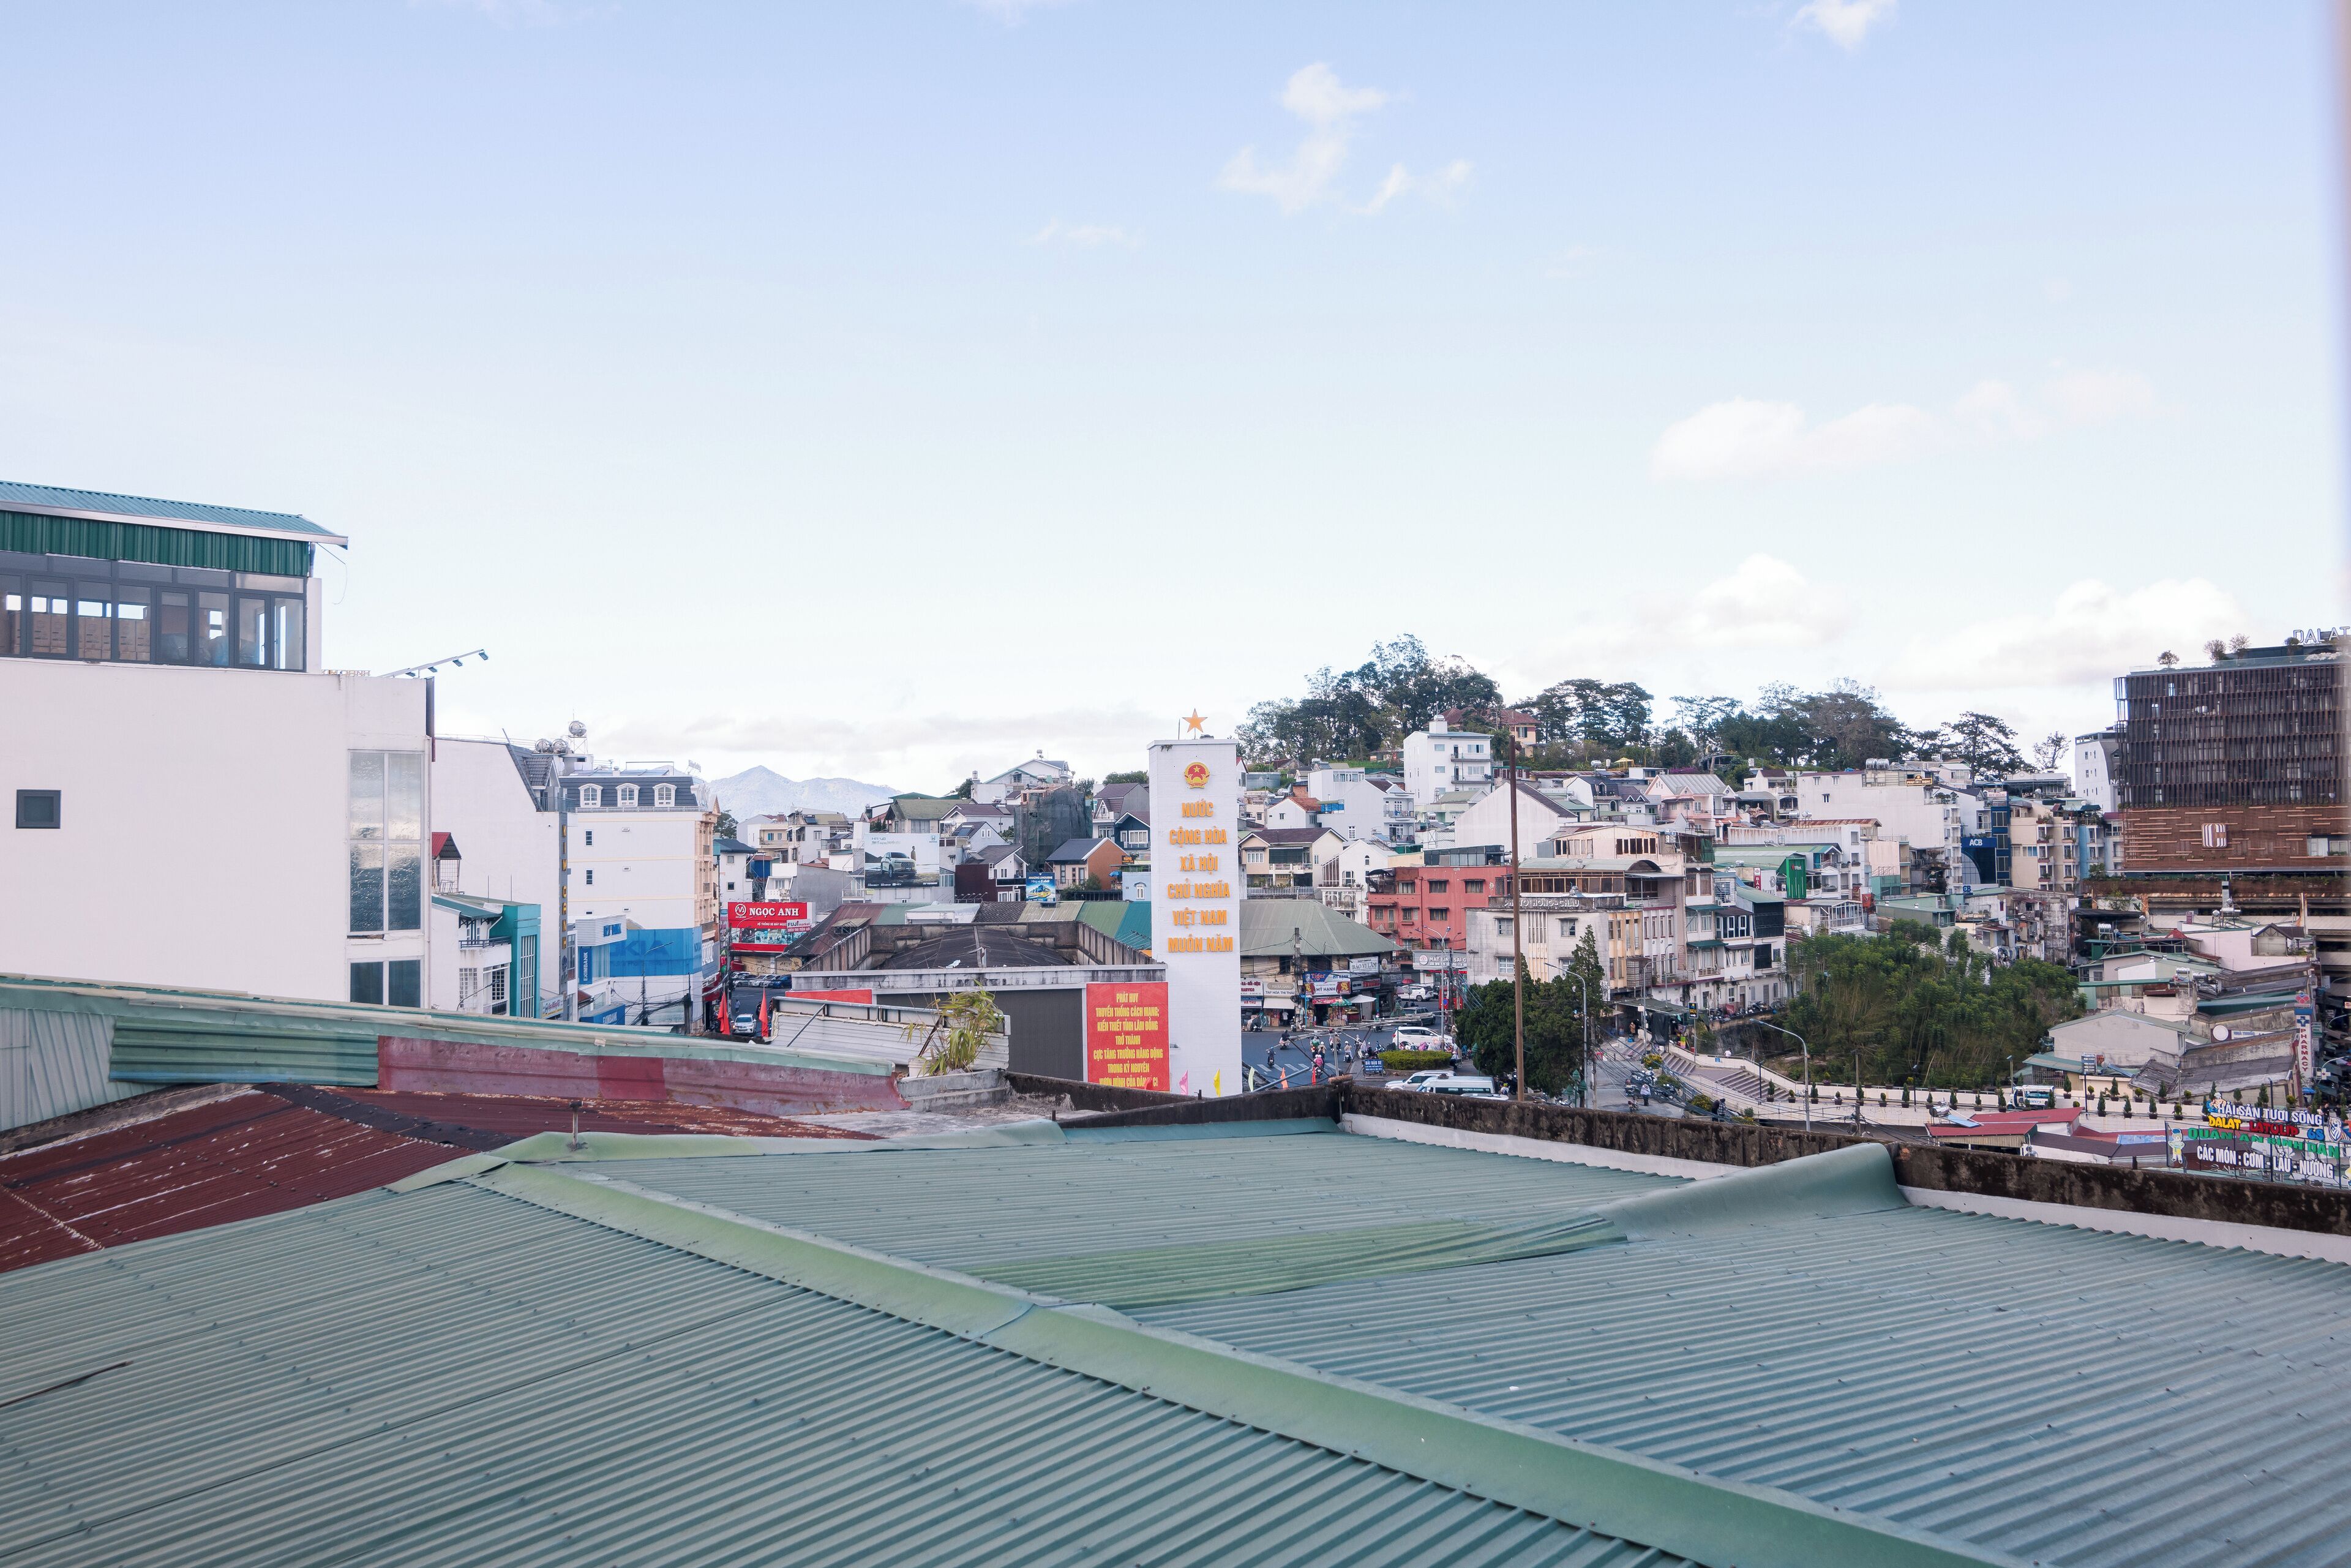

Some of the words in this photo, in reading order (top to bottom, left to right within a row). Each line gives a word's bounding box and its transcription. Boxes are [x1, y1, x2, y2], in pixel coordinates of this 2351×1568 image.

[1182, 798, 1214, 818] NƯỚC
[1169, 826, 1201, 848] CỘNG
[1204, 825, 1227, 844] HÒA
[1180, 853, 1196, 872] XÃ
[1199, 853, 1218, 875] HỘI
[1168, 878, 1191, 898] CHỦ
[1194, 879, 1230, 898] NGHĨA
[749, 908, 775, 918] NGỌC
[1172, 907, 1196, 928] VIỆT
[1201, 910, 1227, 925] NAM
[1168, 934, 1203, 953] MUÔN
[1207, 933, 1233, 952] NĂM
[1116, 992, 1128, 1003] PHÁT
[1129, 993, 1138, 1003] HUY
[1114, 1004, 1130, 1017] THỐNG
[1131, 1006, 1143, 1017] CÁCH
[1098, 1019, 1108, 1031] KIẾN
[1109, 1019, 1122, 1031] THIẾT
[1134, 1019, 1144, 1031] LÂM
[1116, 1033, 1124, 1045] TRỞ
[1125, 1034, 1140, 1045] THÀNH
[1093, 1049, 1103, 1061] CỰC
[1104, 1048, 1116, 1059] TĂNG
[1117, 1047, 1135, 1059] TRƯỞNG
[1136, 1048, 1149, 1058] NĂNG
[1150, 1047, 1163, 1060] ĐỘNG
[1107, 1064, 1123, 1073] TRONG
[1131, 1061, 1149, 1073] NGUYÊN
[1126, 1075, 1136, 1087] CỦA
[2208, 1115, 2241, 1130] DALAT
[2238, 1104, 2260, 1118] SẢN
[2263, 1108, 2288, 1122] TƯƠI
[2291, 1110, 2323, 1126] SỐNG
[2197, 1144, 2214, 1160] CÁC
[2216, 1147, 2237, 1165] MÓN
[2243, 1153, 2264, 1169] CƠM
[2273, 1151, 2291, 1173] LẨU
[2299, 1158, 2334, 1179] NƯỚNG
